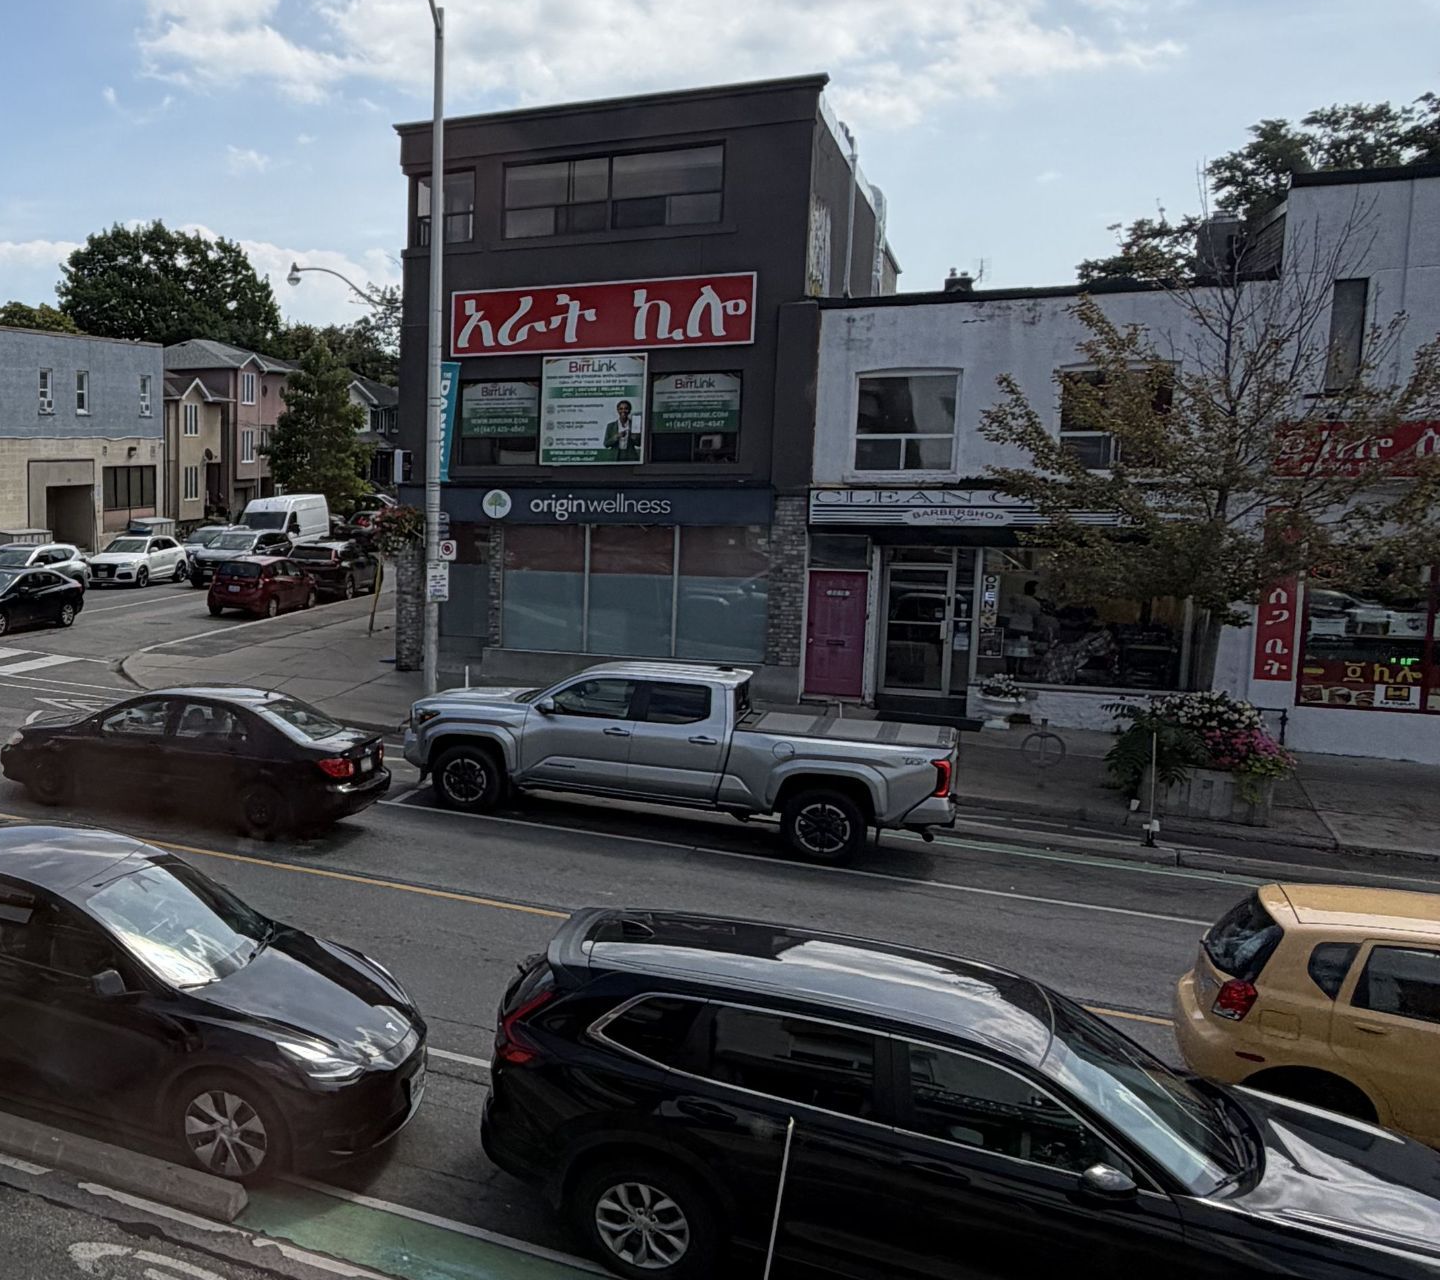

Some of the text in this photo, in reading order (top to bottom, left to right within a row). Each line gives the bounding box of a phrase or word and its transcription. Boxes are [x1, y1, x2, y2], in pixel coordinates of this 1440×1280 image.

[633, 285, 747, 341] ኪሎ
[568, 360, 617, 373] BirrLink
[815, 491, 973, 505] CLEAN
[530, 493, 671, 520] origin wellness
[912, 507, 1004, 520] BARBERSHOP
